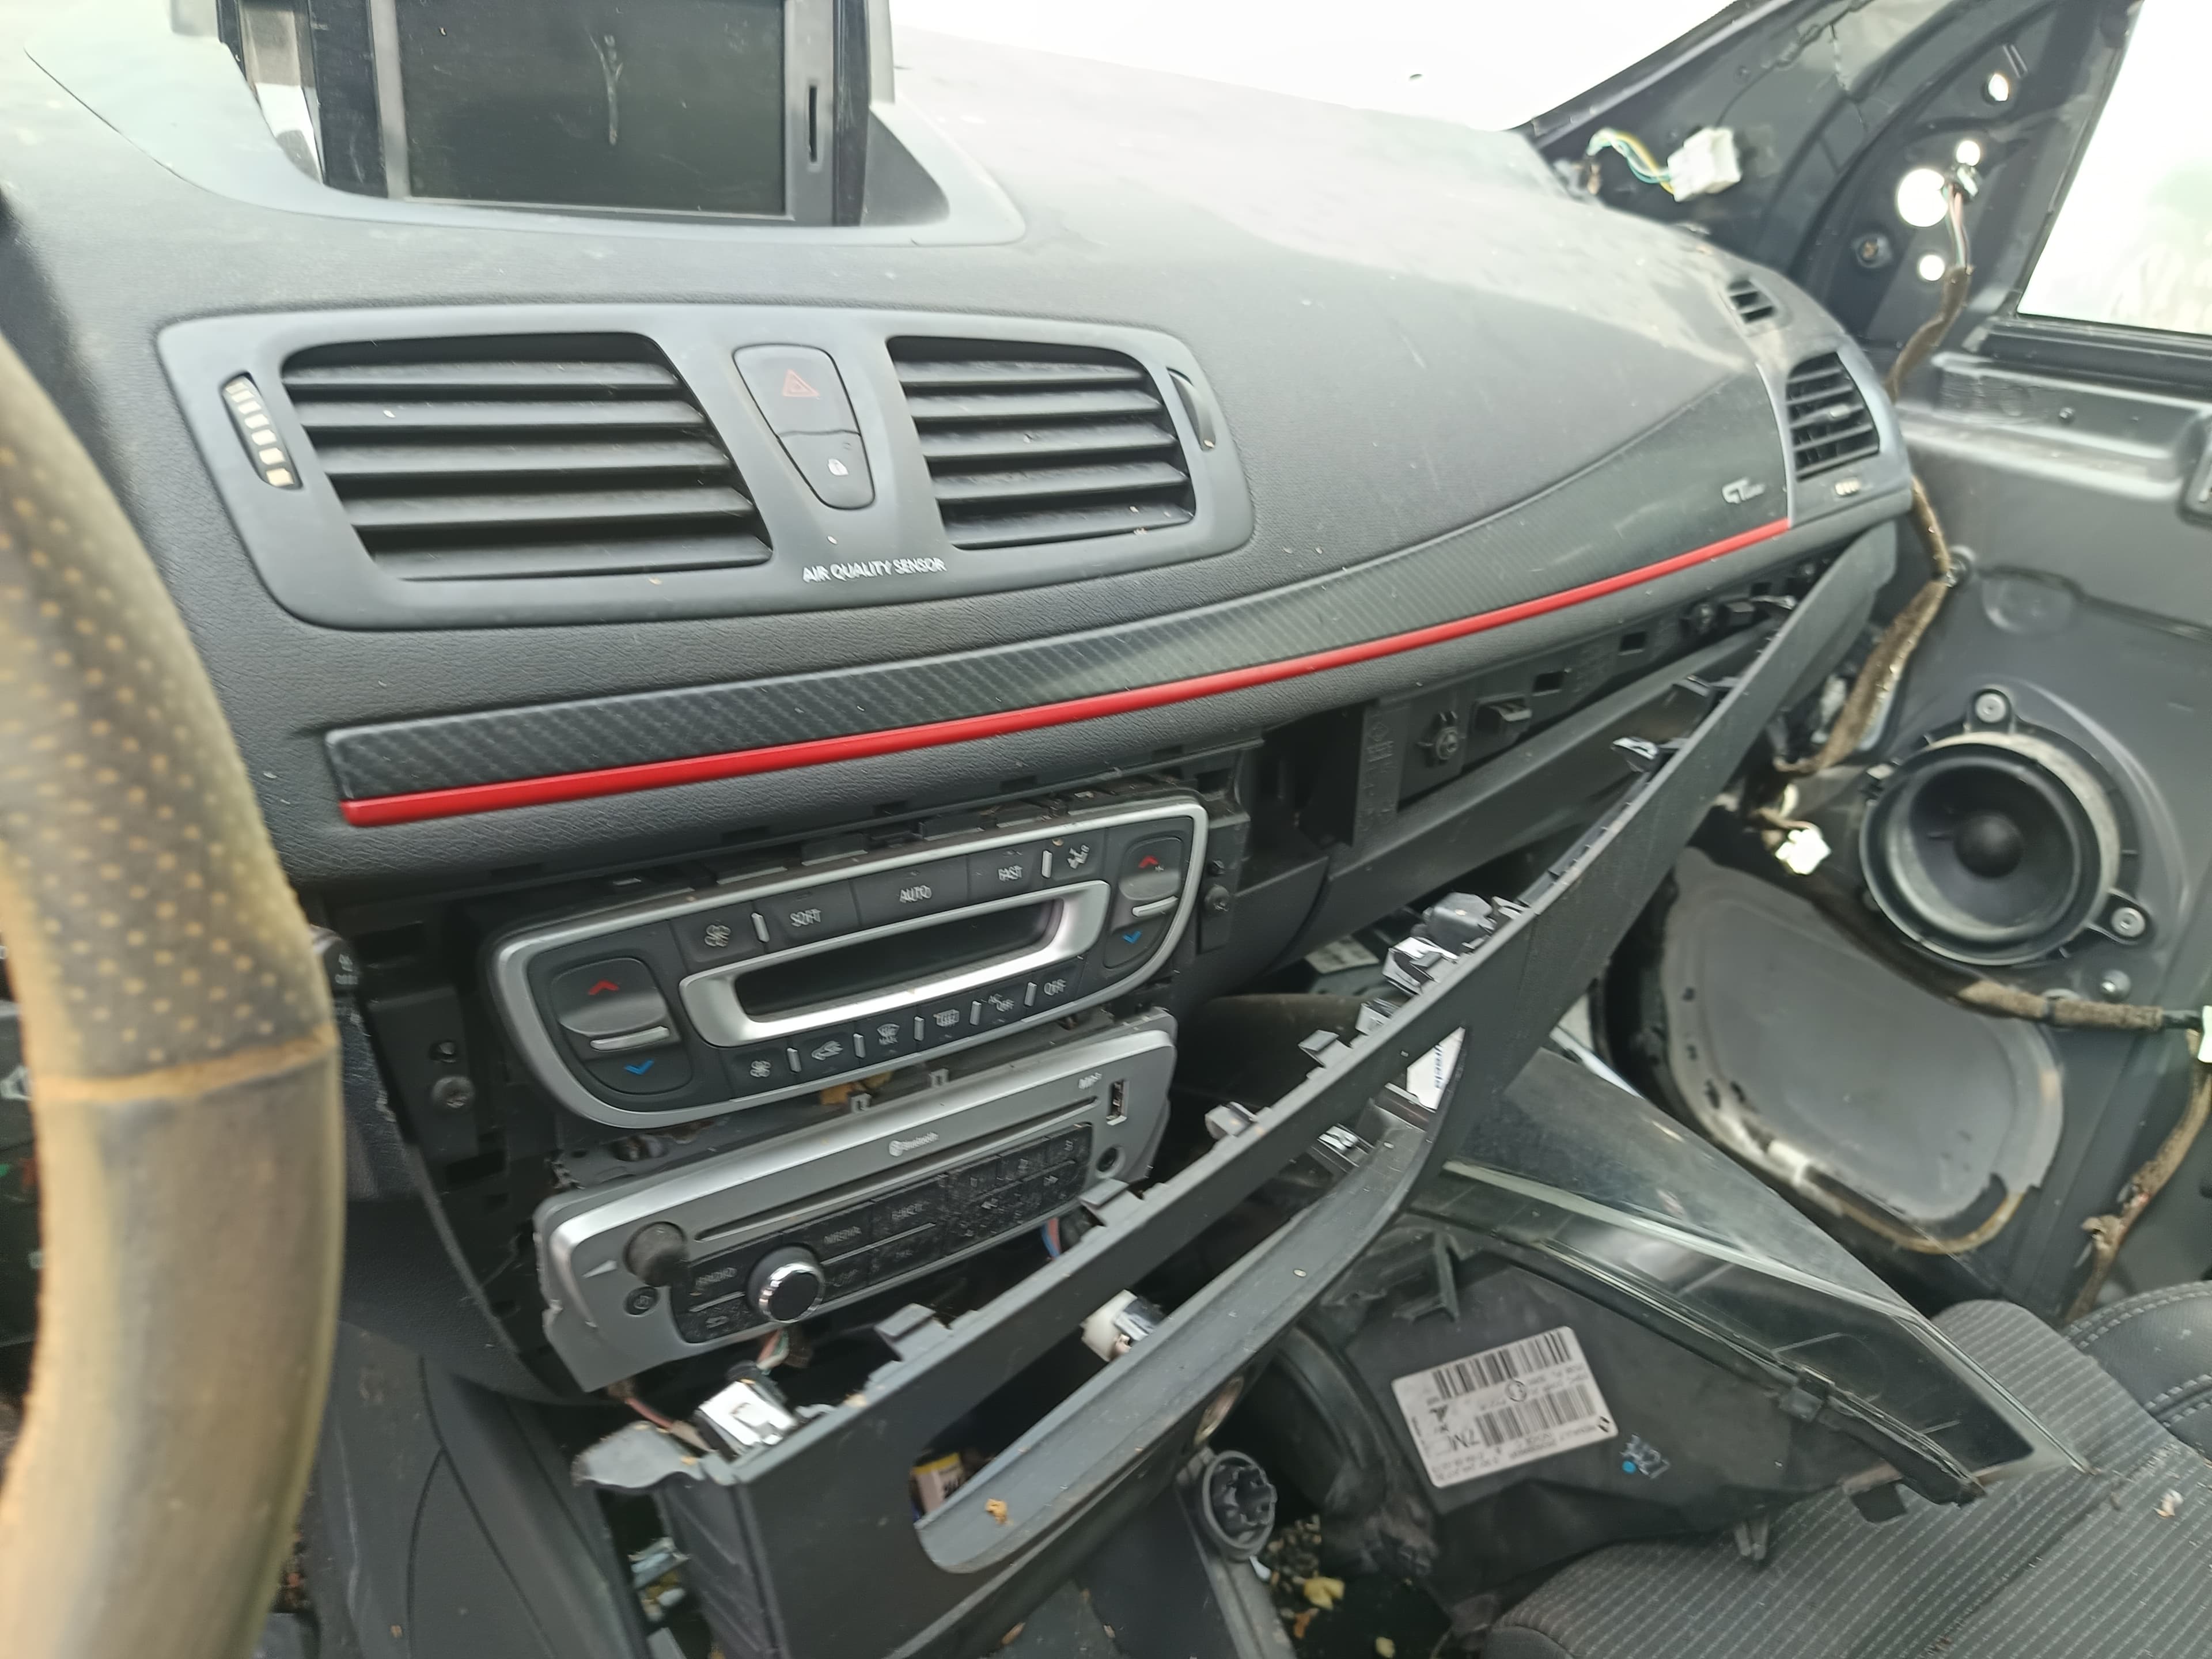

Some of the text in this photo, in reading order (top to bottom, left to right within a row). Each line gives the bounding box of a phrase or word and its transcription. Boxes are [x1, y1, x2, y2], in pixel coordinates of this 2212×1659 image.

[802, 557, 948, 582] AIR QUALITY SENSOR
[899, 885, 932, 903] AUTO
